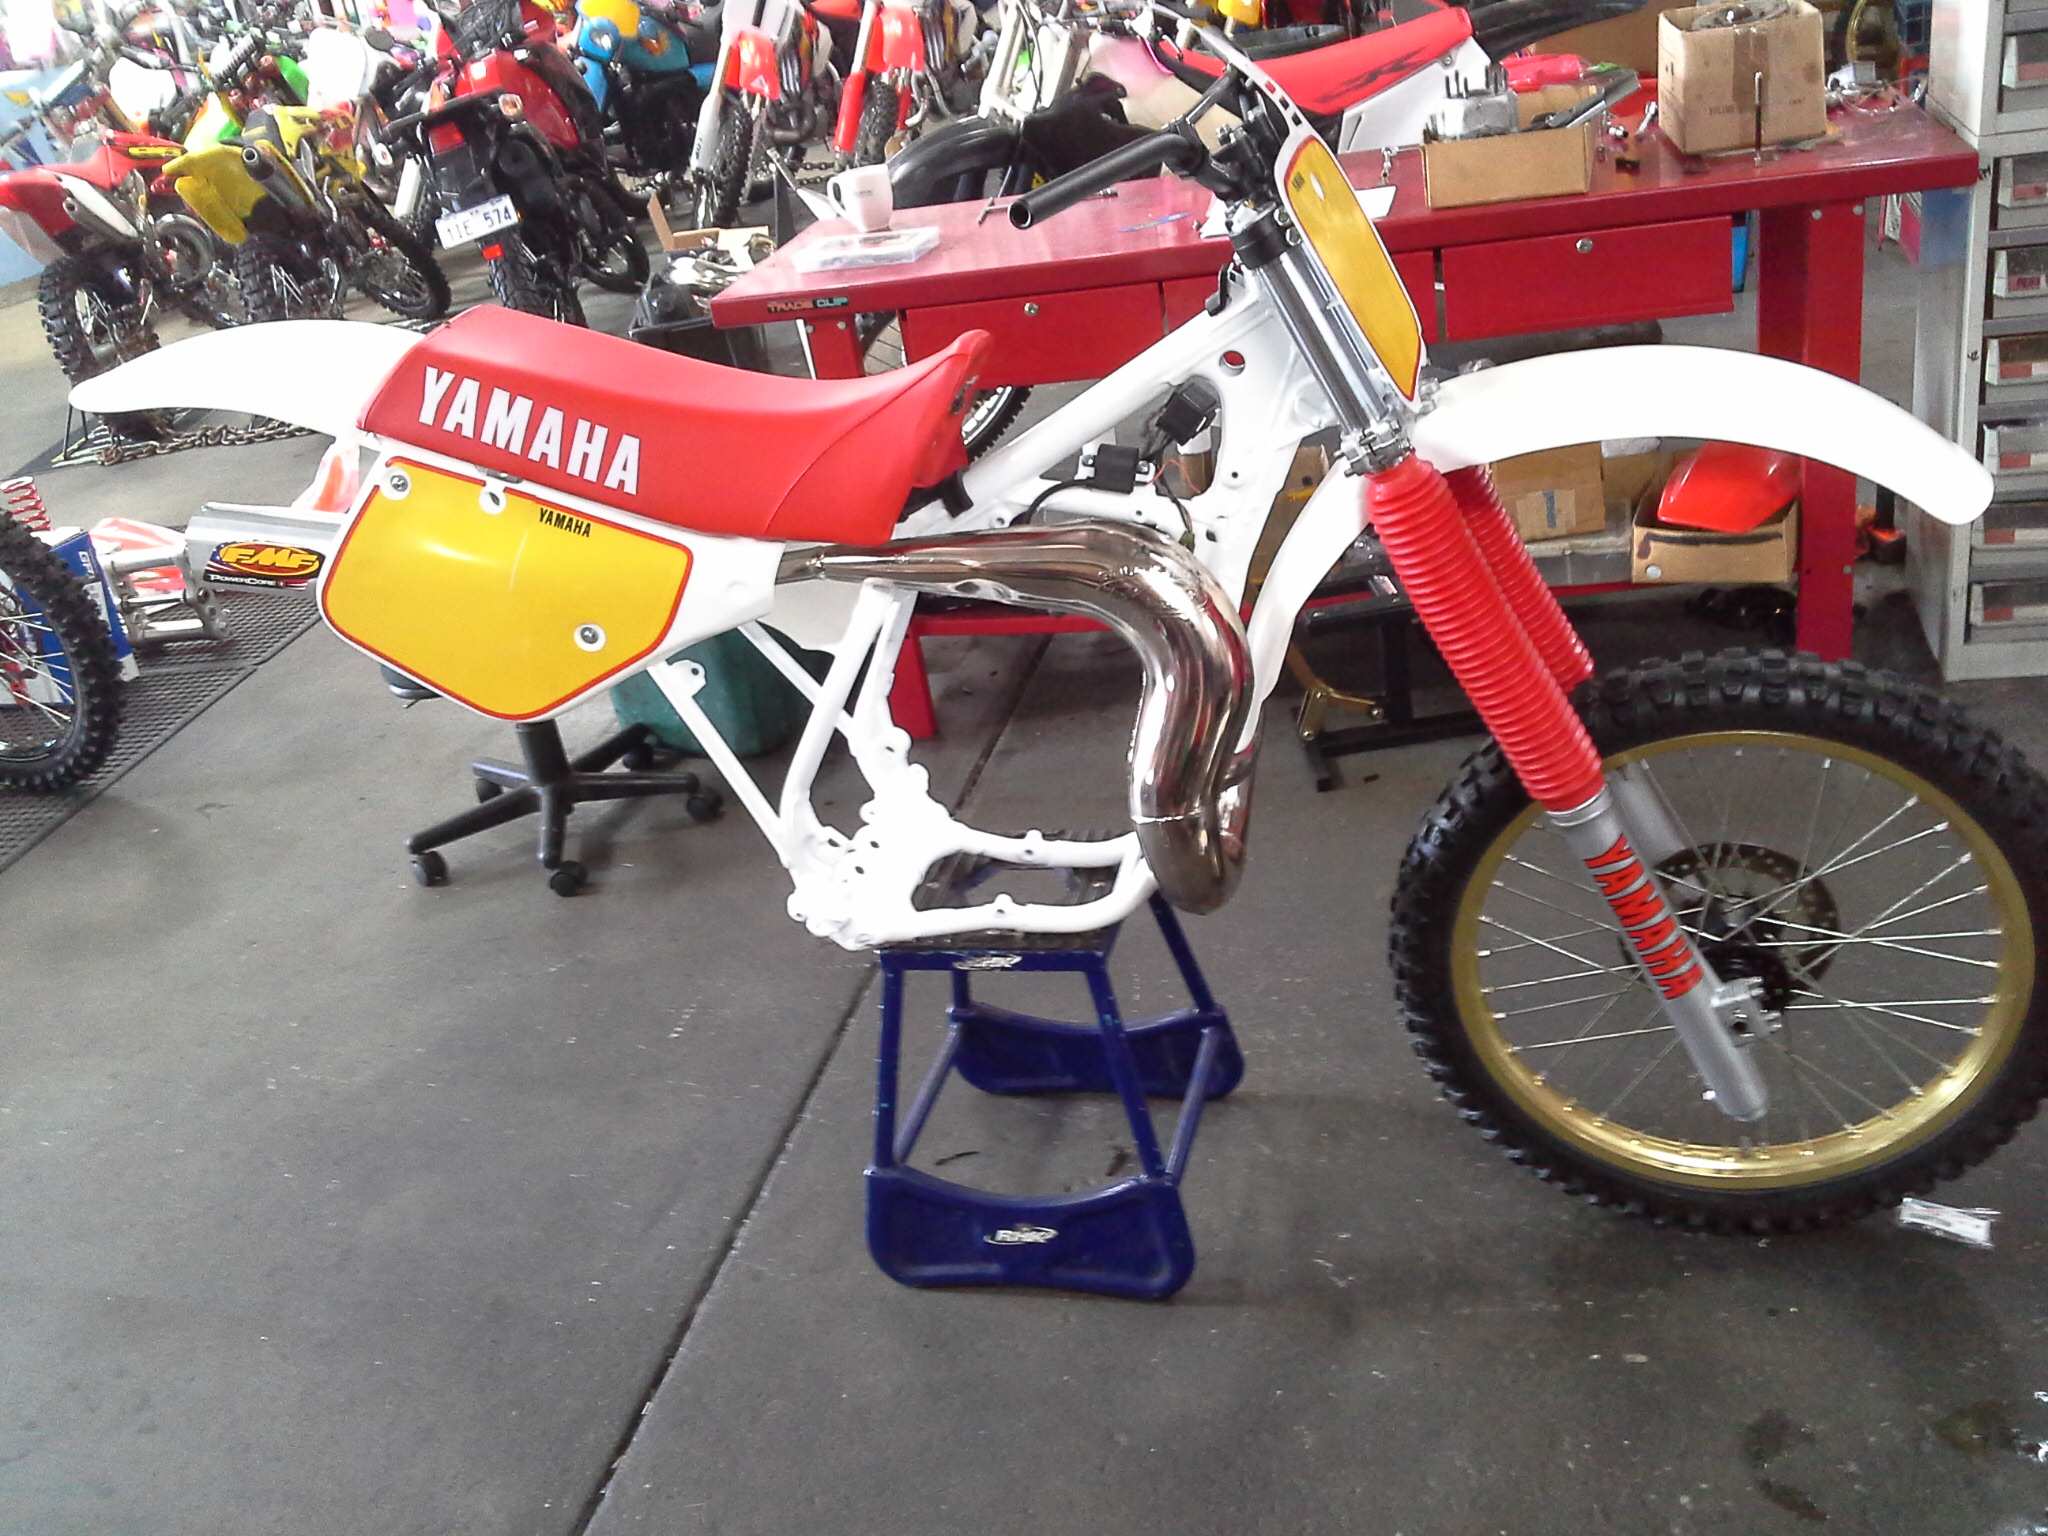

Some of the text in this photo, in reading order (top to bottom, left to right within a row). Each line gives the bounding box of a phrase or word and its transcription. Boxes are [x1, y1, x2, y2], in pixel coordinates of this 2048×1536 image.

[483, 205, 513, 228] 574
[418, 365, 641, 496] YAMAHA
[539, 507, 592, 538] YAMAHA
[221, 546, 318, 570] FMF
[1584, 832, 1705, 1001] YAMAHA
